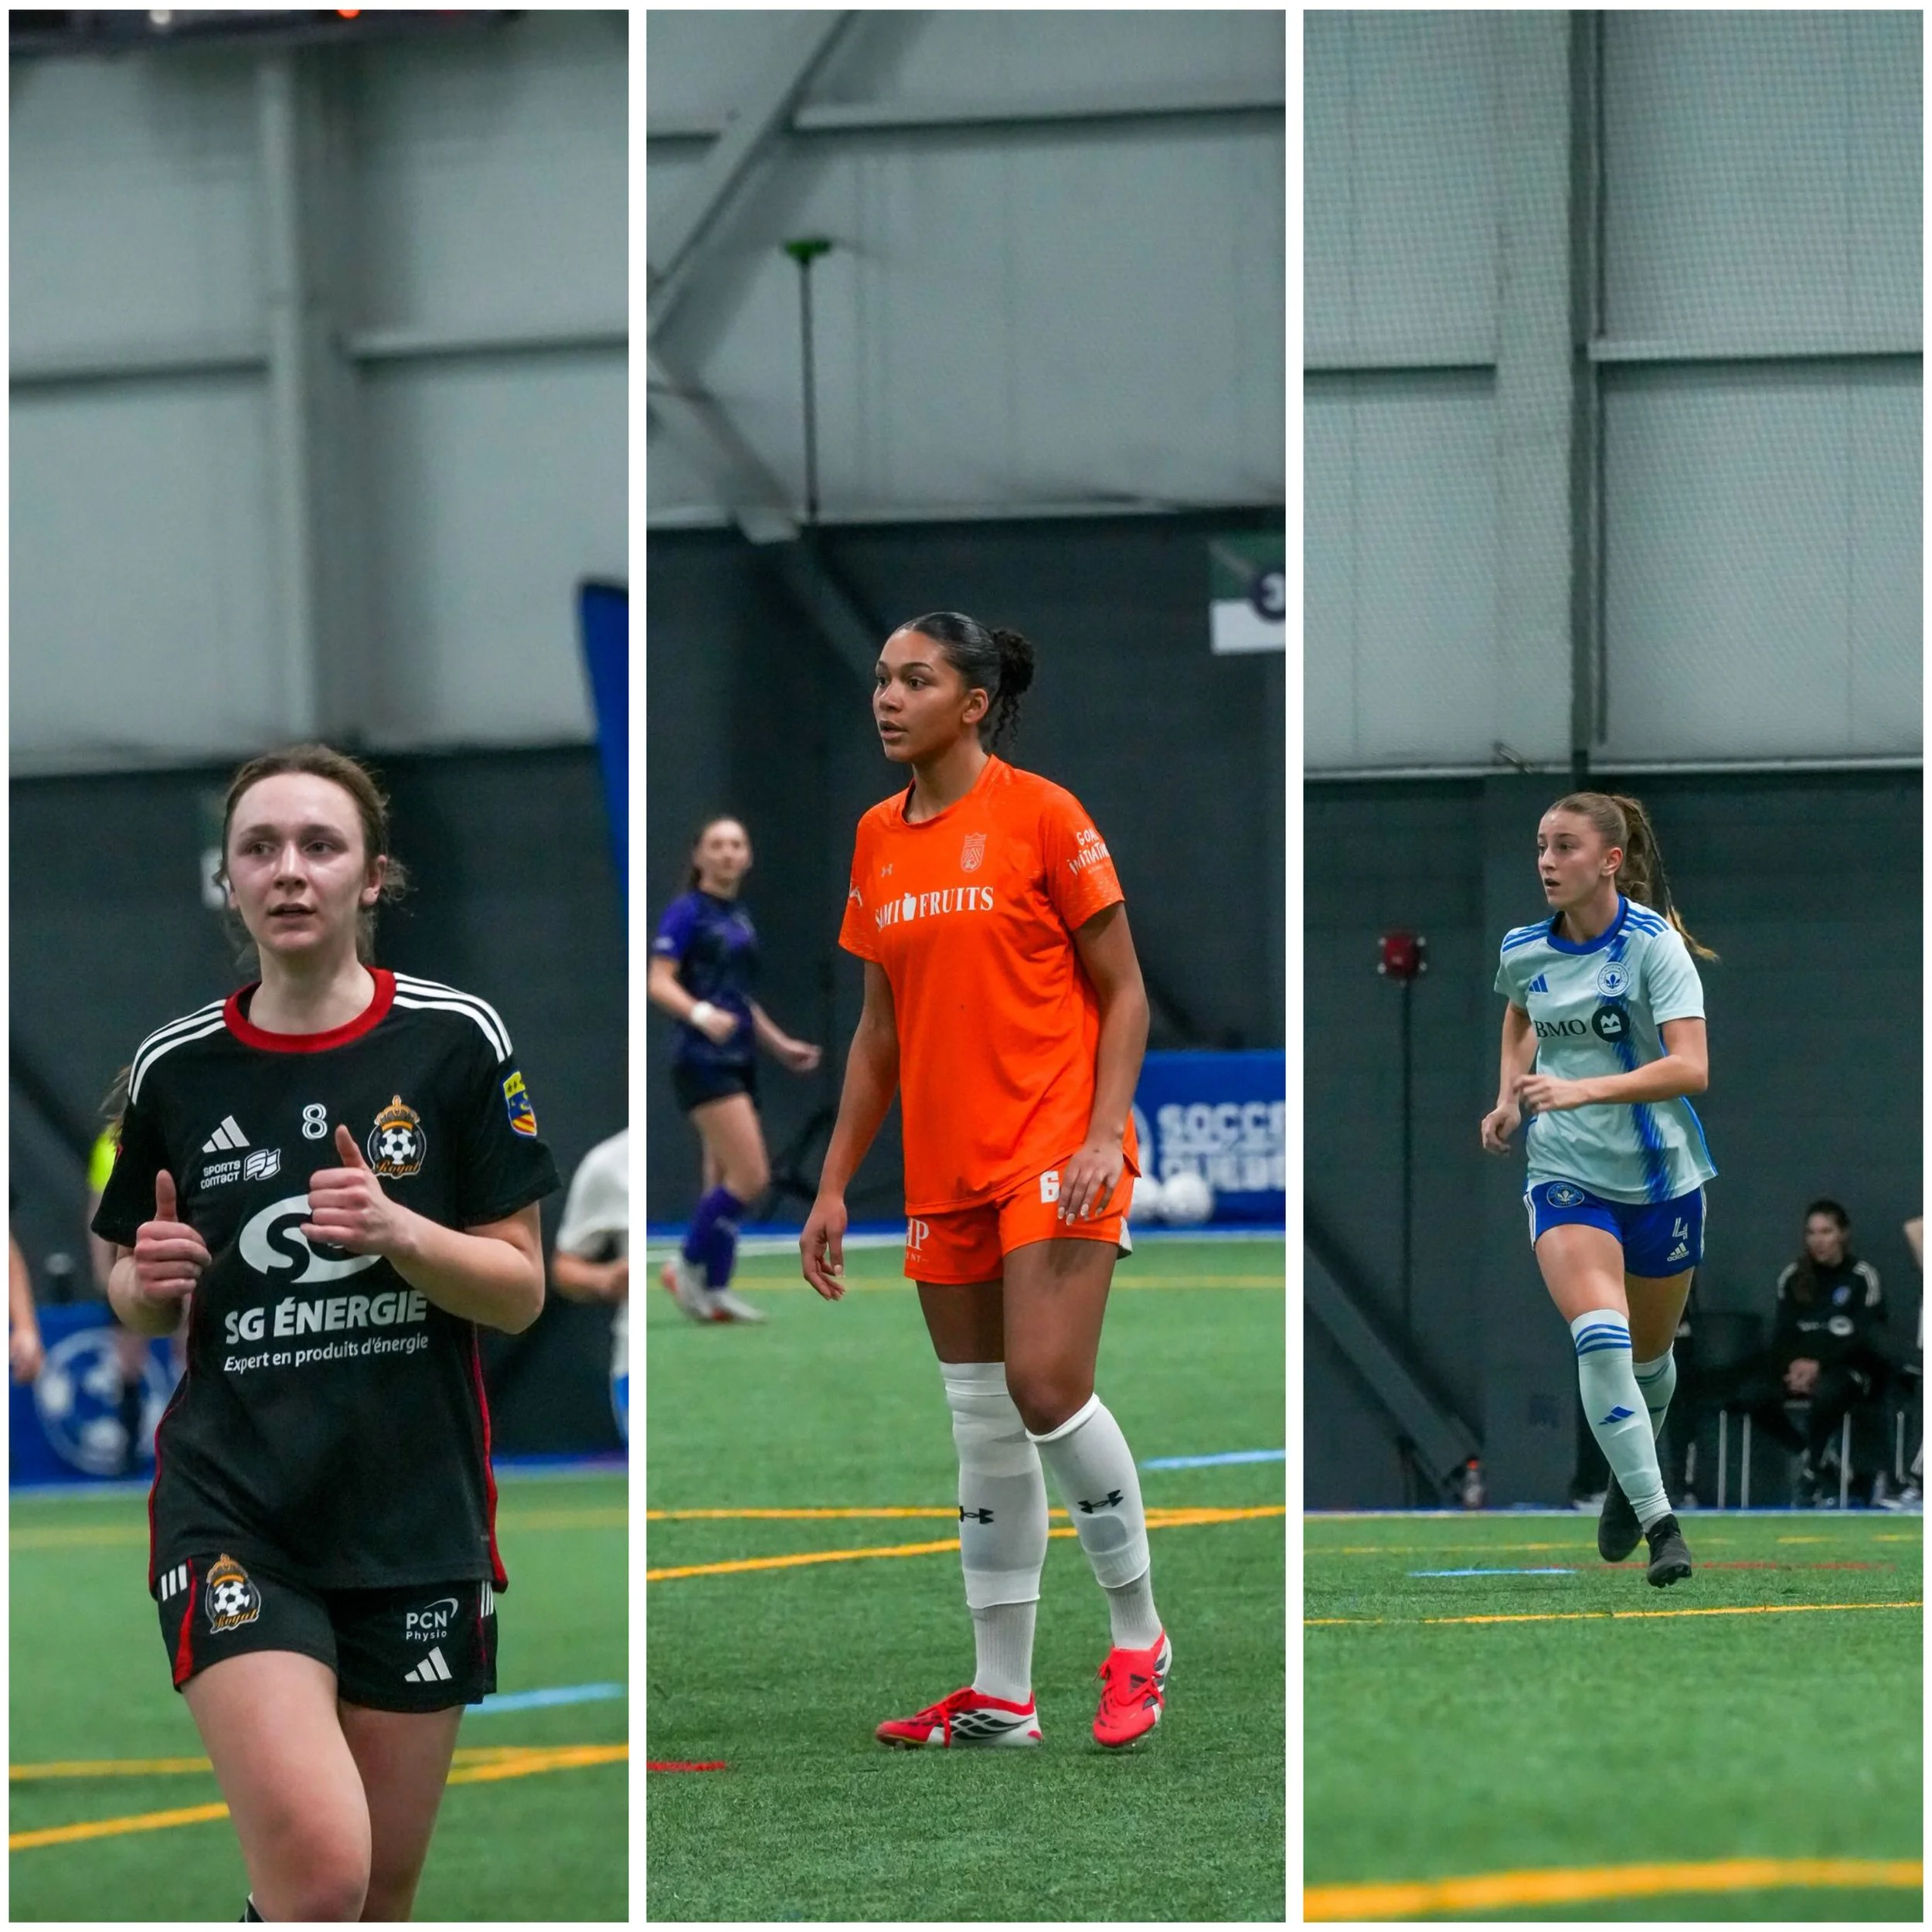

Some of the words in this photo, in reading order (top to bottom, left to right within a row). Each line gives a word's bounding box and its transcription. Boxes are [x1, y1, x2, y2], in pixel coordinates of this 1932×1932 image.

[919, 886, 994, 918] FRUITS
[1534, 1019, 1587, 1038] BMO
[302, 1103, 328, 1141] 8
[203, 1160, 240, 1177] SPORTS
[376, 1159, 420, 1175] Royal
[1039, 1170, 1060, 1204] 6
[1672, 1217, 1688, 1240] 4
[225, 1307, 265, 1345] SG
[274, 1290, 427, 1338] ÉNERGIE
[223, 1352, 270, 1374] Expert
[273, 1353, 291, 1366] en
[295, 1341, 359, 1367] produits
[361, 1332, 429, 1355] d'énergie
[216, 1608, 257, 1628] Royal
[406, 1610, 447, 1630] PCN
[406, 1629, 447, 1641] Physio
